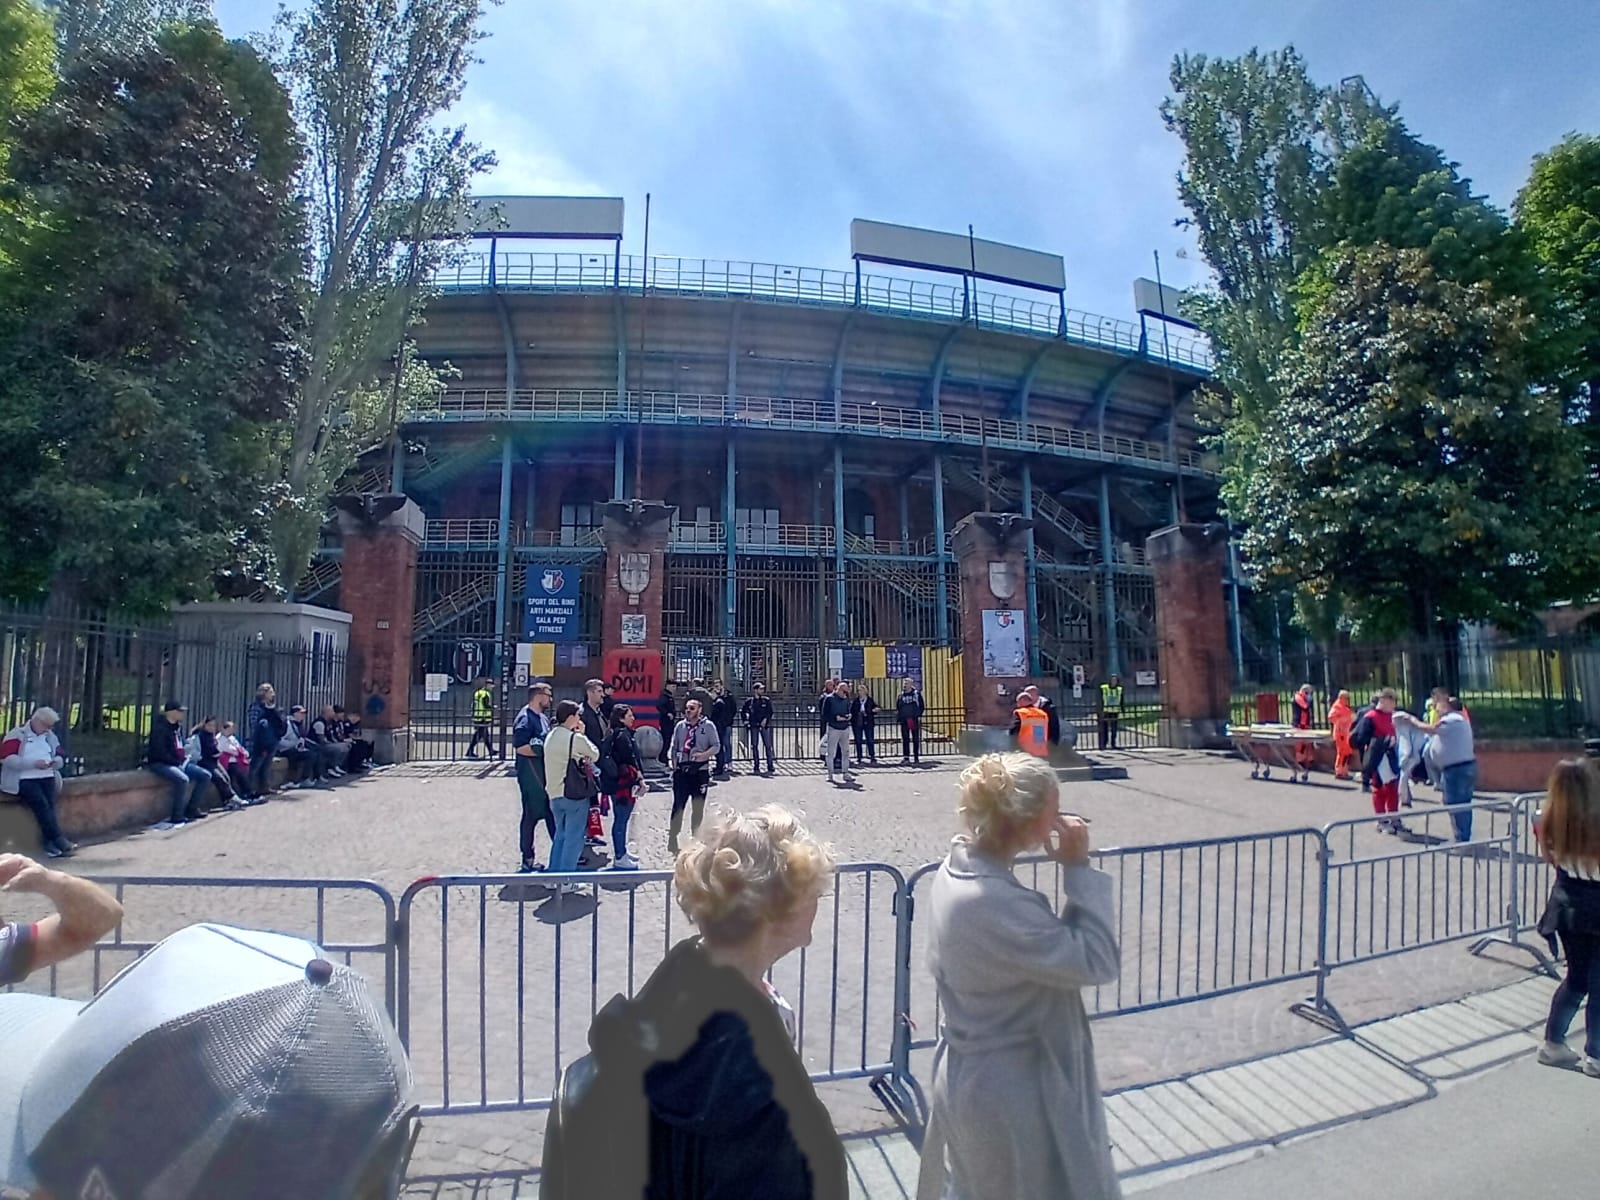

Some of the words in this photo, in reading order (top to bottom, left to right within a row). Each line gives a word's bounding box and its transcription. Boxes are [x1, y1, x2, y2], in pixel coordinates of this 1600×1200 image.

[561, 598, 575, 606] RING
[530, 607, 544, 615] ARTI
[545, 607, 573, 615] MARZIALI
[536, 616, 551, 624] SALA
[553, 616, 566, 624] PESI
[539, 625, 563, 633] FITNESS
[618, 657, 645, 673] MAI
[612, 674, 653, 694] DOMI
